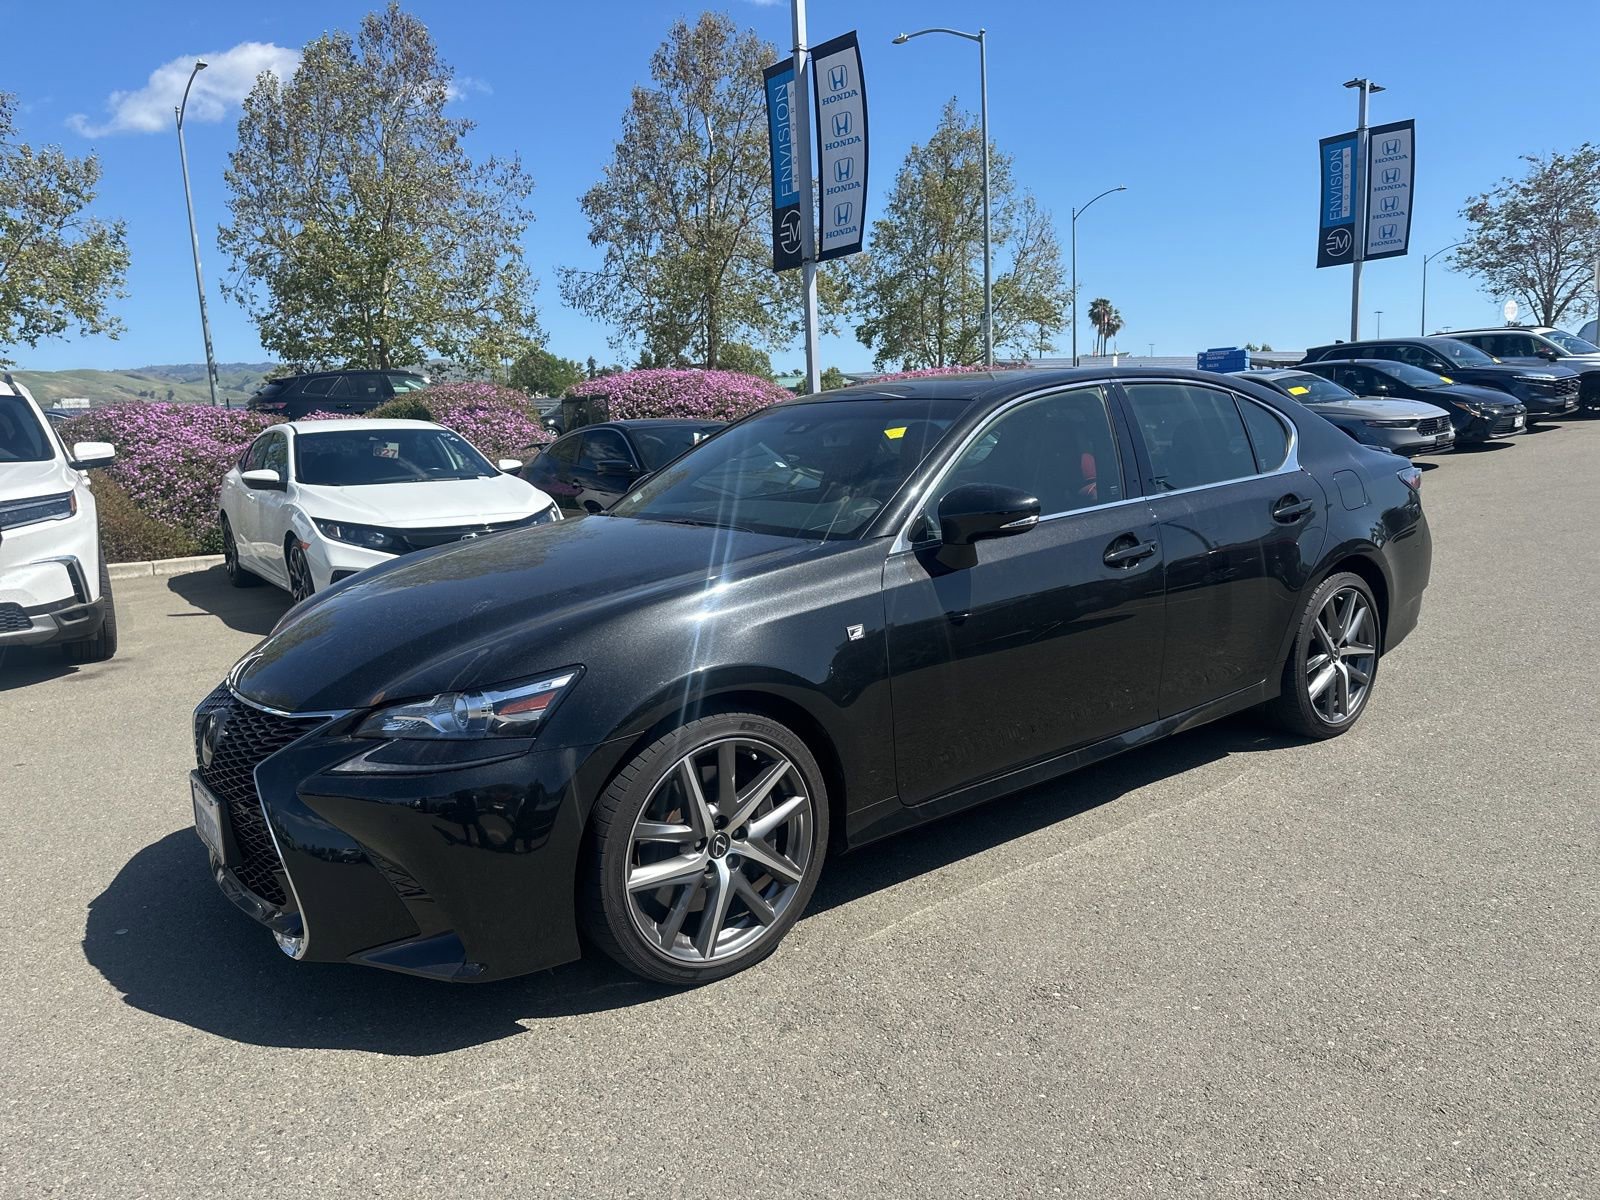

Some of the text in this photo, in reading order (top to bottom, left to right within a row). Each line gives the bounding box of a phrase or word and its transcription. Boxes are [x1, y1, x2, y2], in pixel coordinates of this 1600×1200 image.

[822, 89, 858, 106] HONDA
[775, 84, 792, 196] ENVISION
[789, 91, 799, 183] MOTORS
[825, 135, 862, 151] HONDA
[1375, 154, 1408, 164] HONDA
[826, 181, 861, 196] HONDA
[1329, 148, 1342, 221] ENVISION
[1374, 183, 1408, 192] HONDA
[1372, 211, 1405, 220] HONDA
[825, 225, 858, 239] HONDA
[1371, 238, 1402, 247] HONDA
